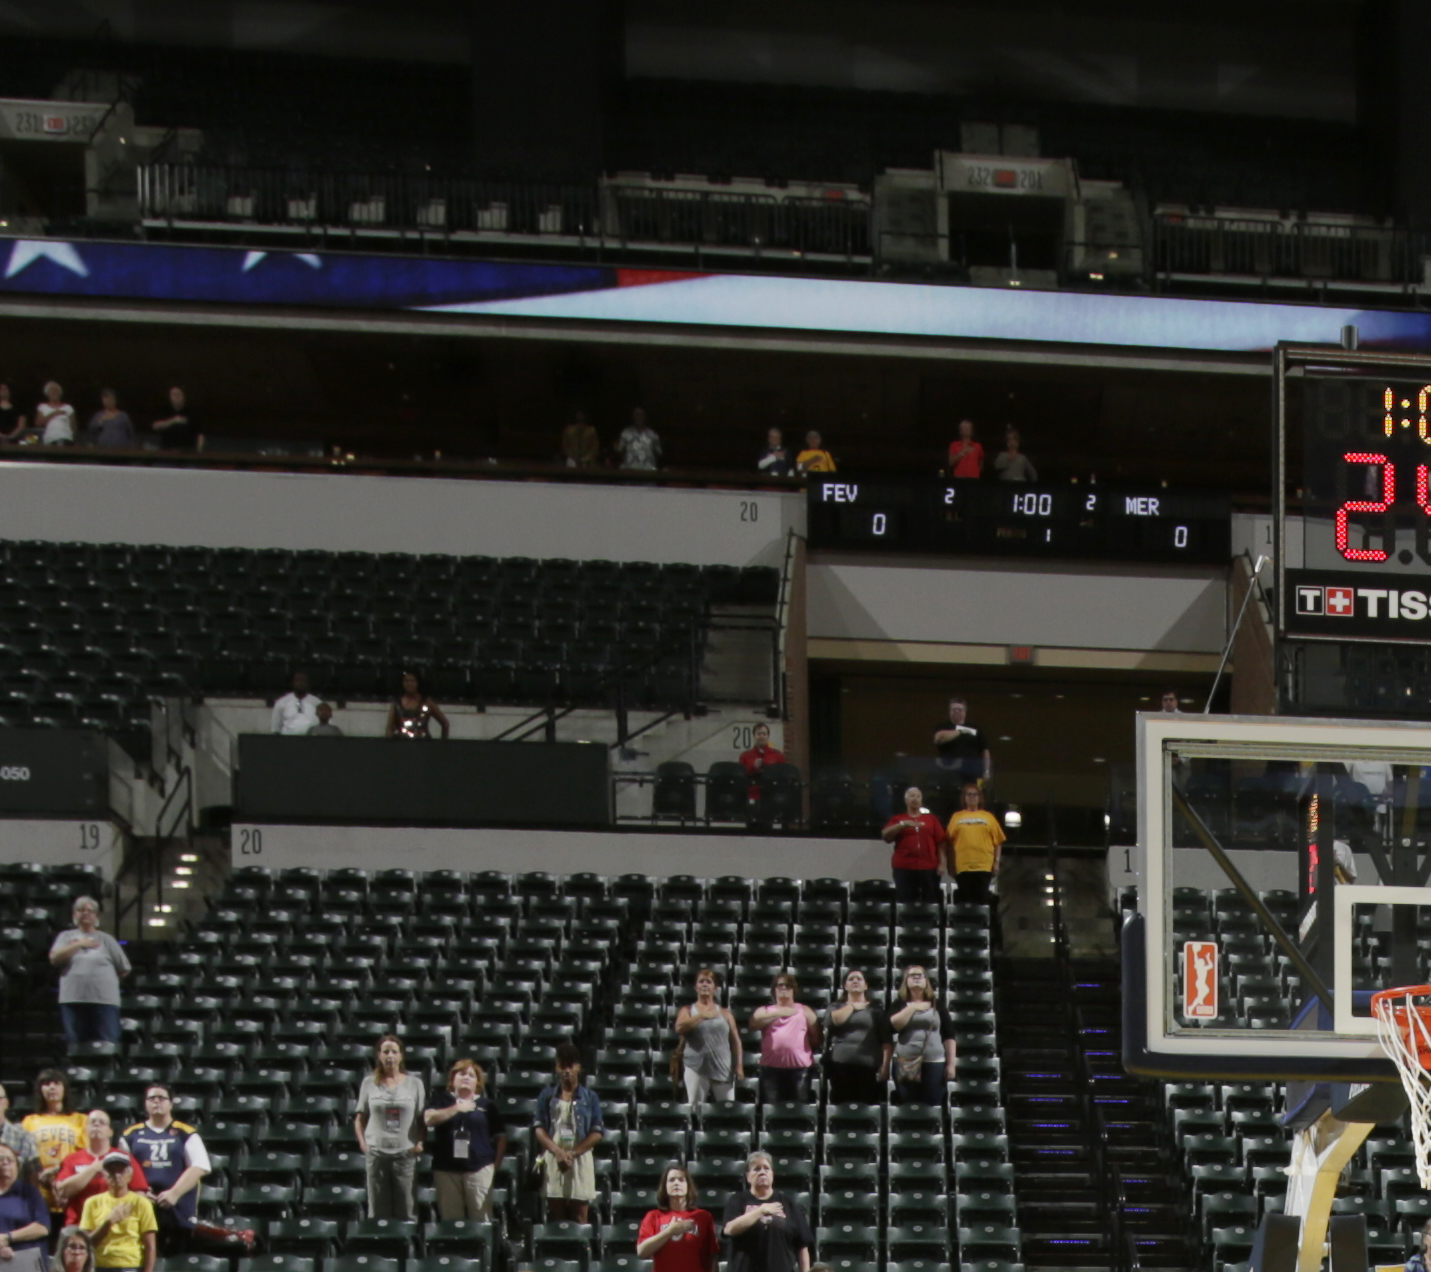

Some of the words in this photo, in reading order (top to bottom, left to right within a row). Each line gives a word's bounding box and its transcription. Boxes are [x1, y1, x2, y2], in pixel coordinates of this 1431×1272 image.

[821, 483, 858, 502] FEV
[944, 488, 955, 505] 2
[1086, 495, 1096, 511] 2
[740, 502, 758, 523] 20
[1012, 493, 1053, 517] 1:00
[1124, 496, 1160, 516] MER
[872, 513, 886, 536] 0
[1173, 525, 1188, 548] 0
[733, 726, 752, 750] 20
[79, 825, 100, 850] 19
[241, 829, 262, 855] 20
[1123, 848, 1131, 873] 1
[40, 1127, 77, 1145] EVER
[149, 1143, 168, 1161] 24
